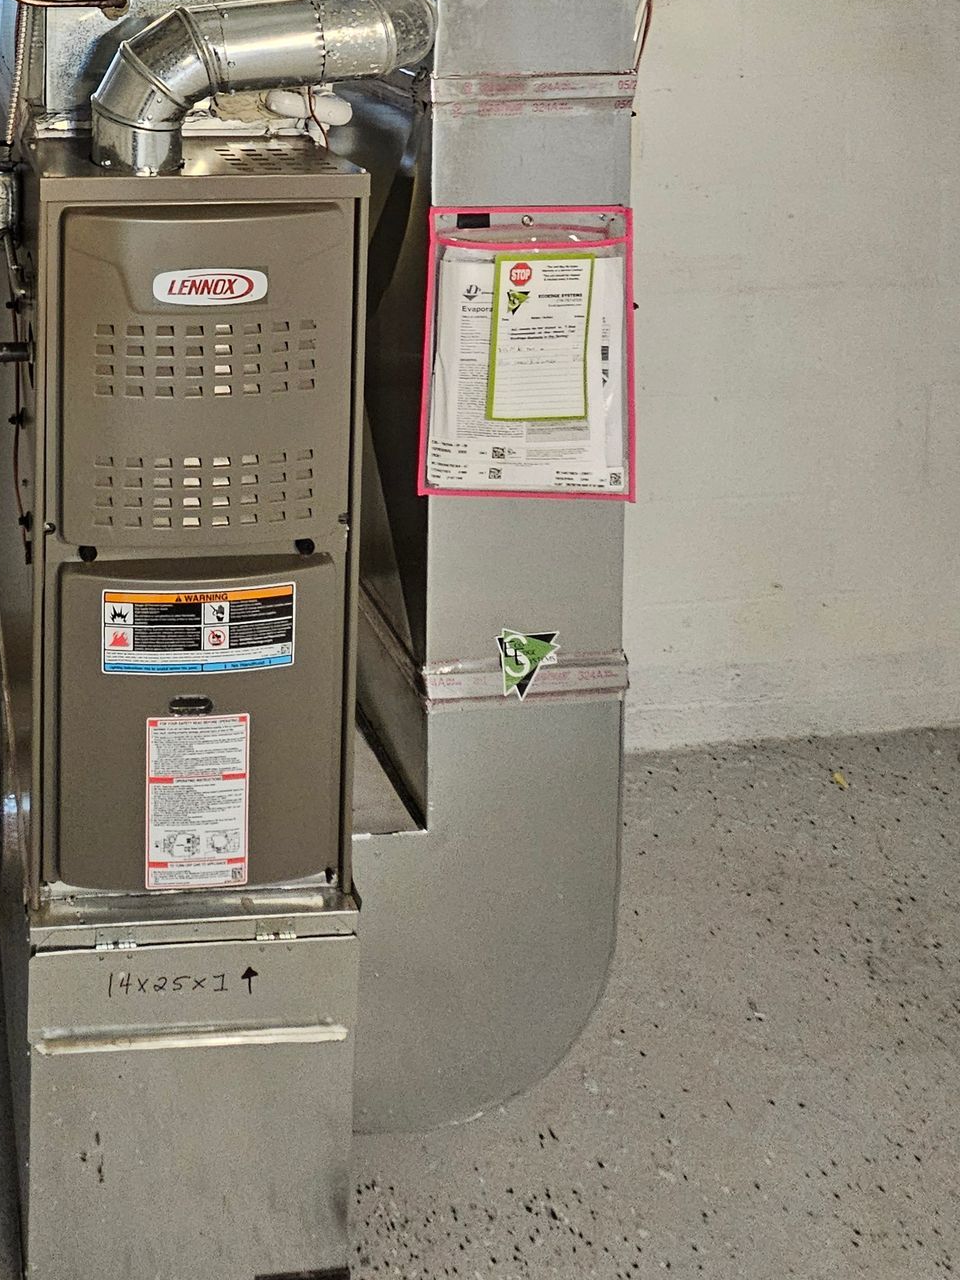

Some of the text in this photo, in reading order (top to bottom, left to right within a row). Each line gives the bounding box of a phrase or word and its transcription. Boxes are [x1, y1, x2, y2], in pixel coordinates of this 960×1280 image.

[510, 268, 531, 281] STOP
[167, 278, 238, 296] LENNOX
[184, 593, 229, 603] WARNING
